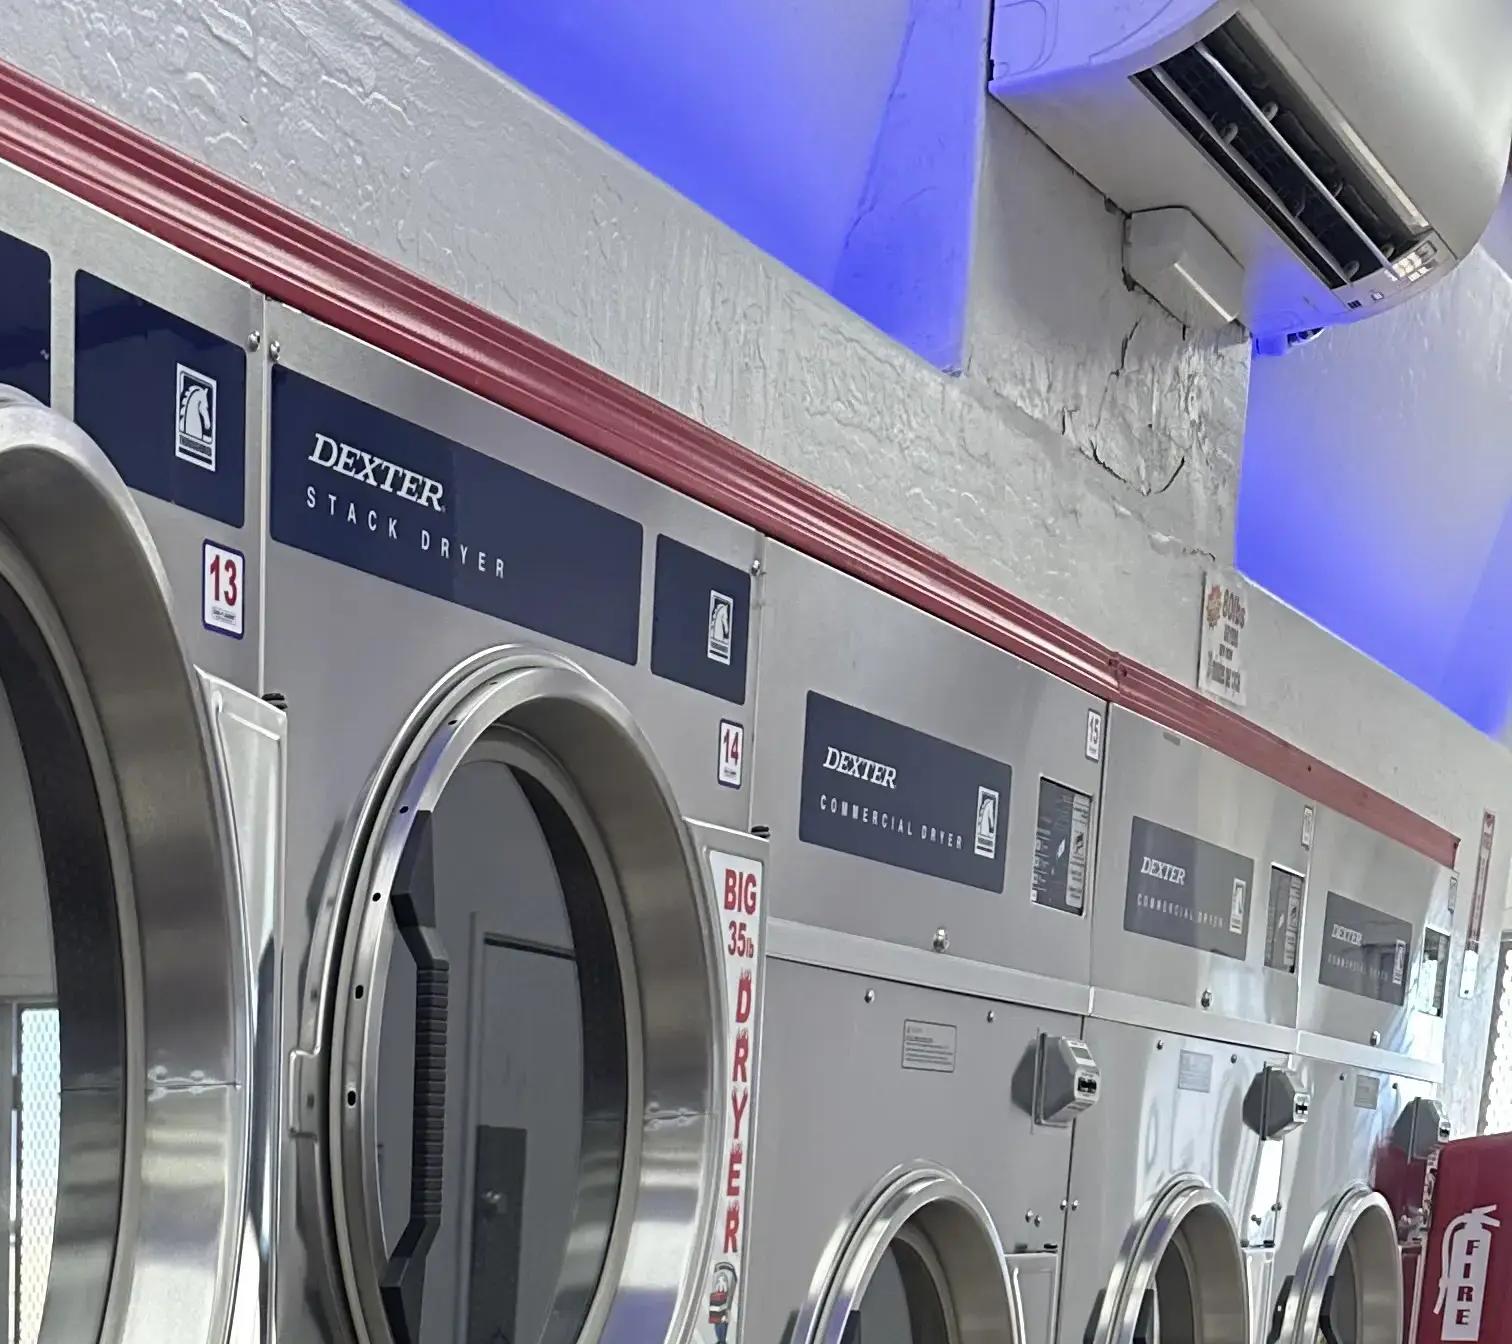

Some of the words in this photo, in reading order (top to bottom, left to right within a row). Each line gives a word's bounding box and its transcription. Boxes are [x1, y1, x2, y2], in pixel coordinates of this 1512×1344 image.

[308, 432, 444, 512] DEXTER
[307, 486, 398, 539] STACK
[421, 529, 504, 578] DRYER
[210, 554, 237, 607] 13
[724, 728, 739, 766] 14
[823, 746, 897, 789] DEXTER
[820, 794, 912, 836] COMMERCIAL
[921, 825, 963, 850] DRYER
[724, 868, 757, 915] BIG
[1140, 856, 1186, 886] DEXTER
[728, 920, 754, 959] 35lb
[1331, 923, 1363, 947] DEXTER
[723, 970, 752, 1254] DRYER
[1454, 1239, 1480, 1325] FIRE
